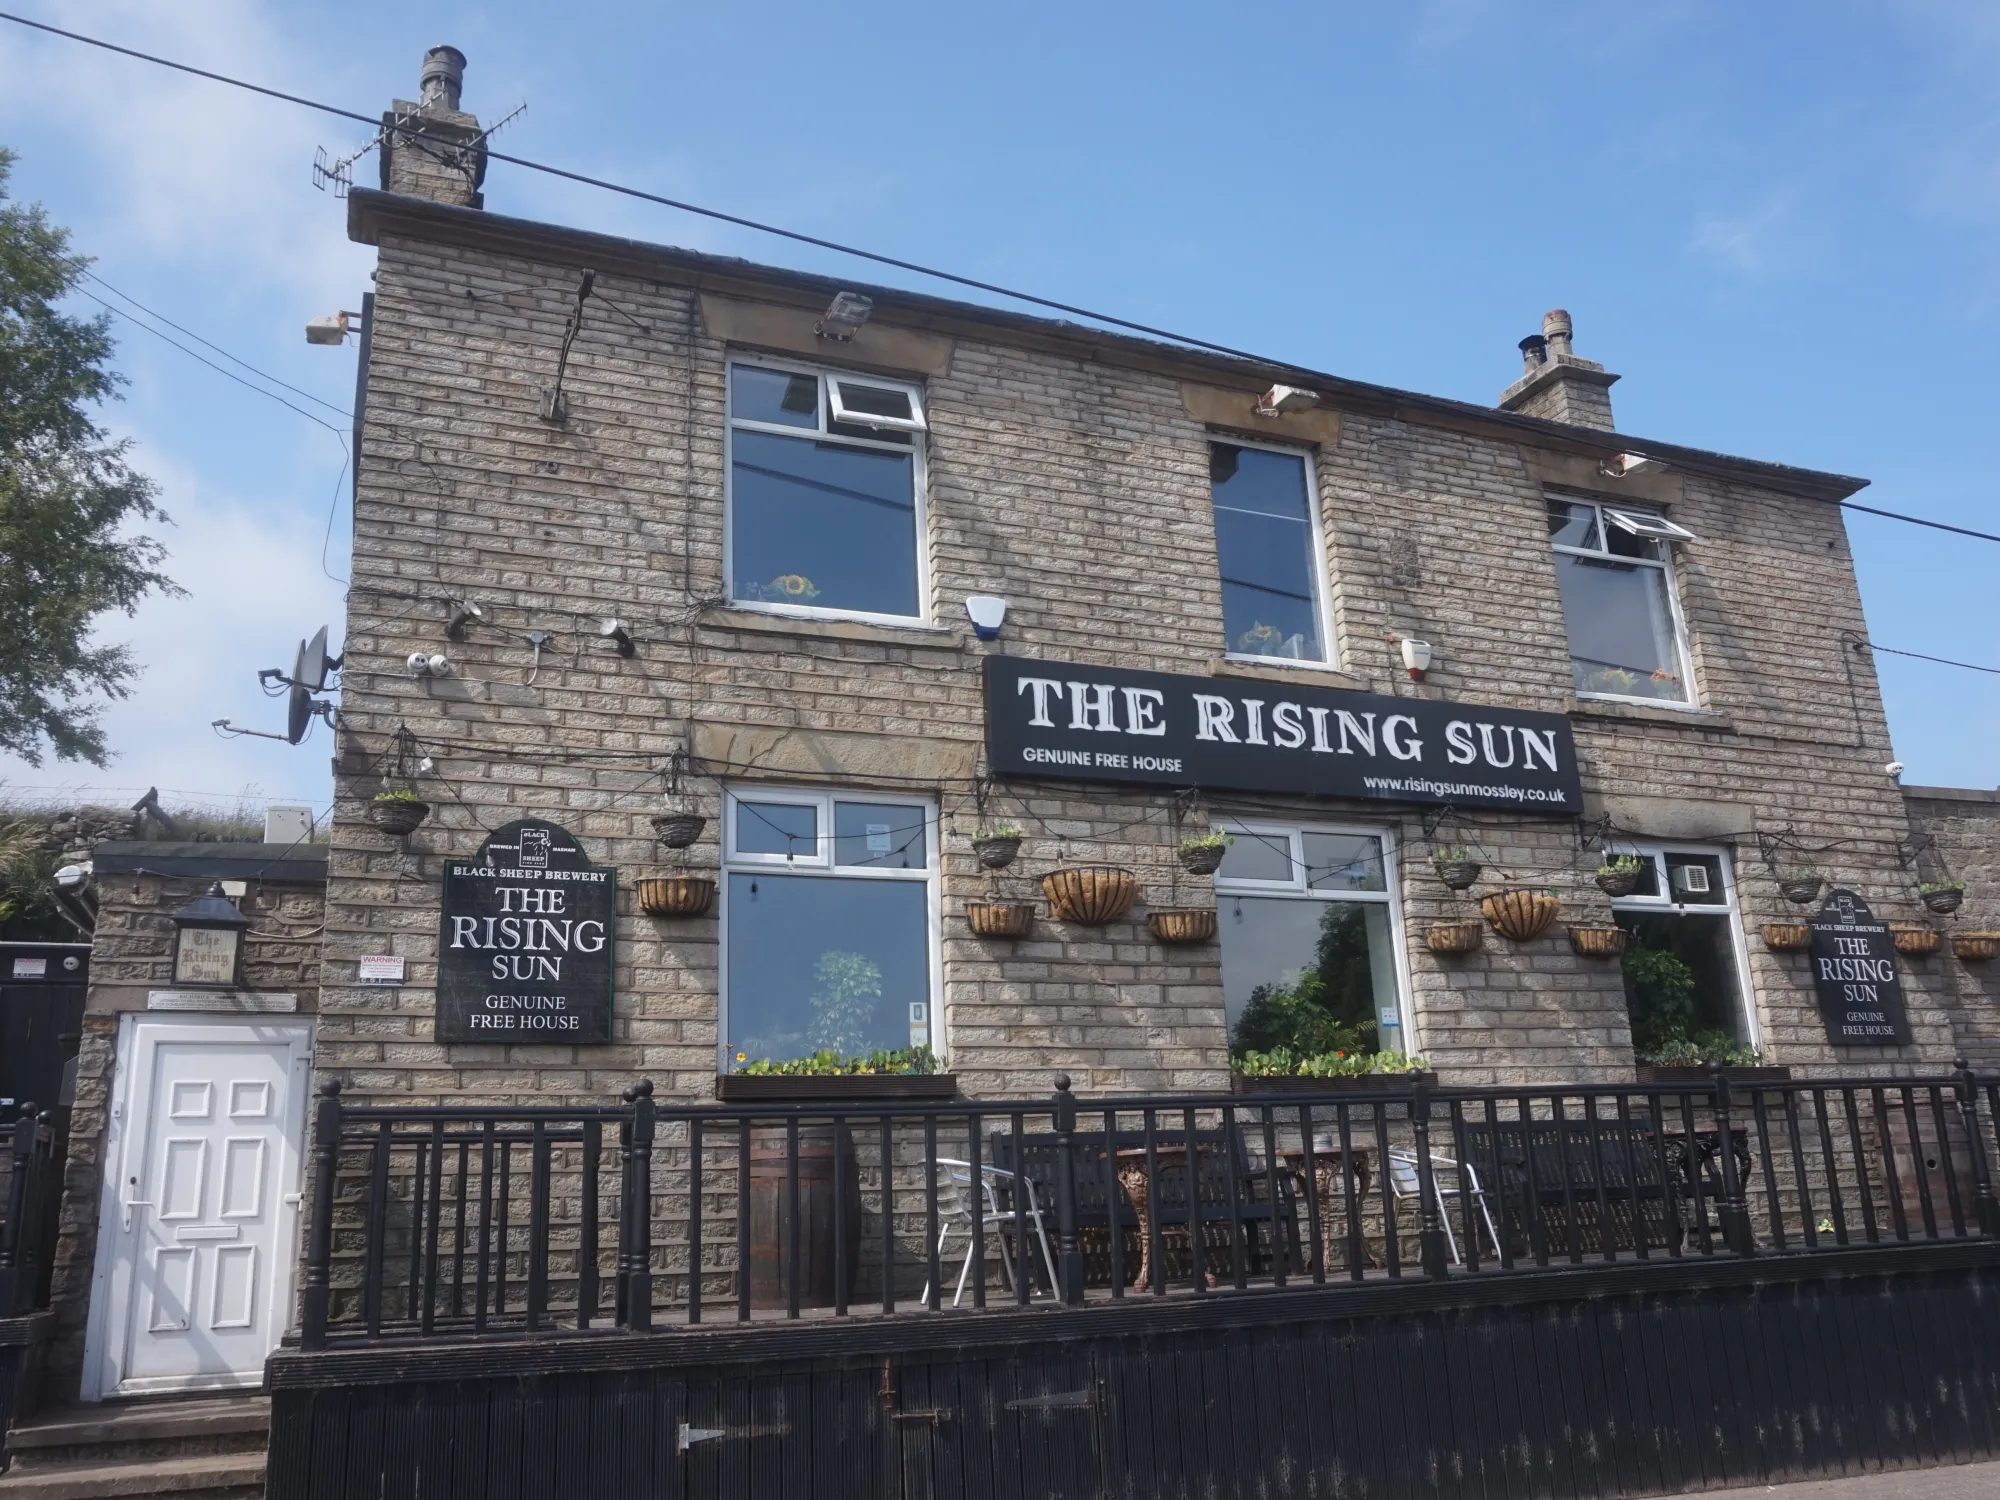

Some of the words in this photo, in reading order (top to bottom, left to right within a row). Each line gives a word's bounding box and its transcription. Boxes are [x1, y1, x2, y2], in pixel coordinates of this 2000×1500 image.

[1017, 677, 1166, 736] THE
[1192, 693, 1424, 762] RISING
[1445, 720, 1558, 771] SUN
[1023, 747, 1091, 766] GENUINE
[1096, 753, 1129, 769] FREE
[1133, 756, 1182, 772] HOUSE
[1364, 776, 1566, 803] www.risingsunmossley.co.uk
[453, 867, 496, 877] BLACK
[499, 868, 542, 879] SHEEP
[545, 870, 607, 882] BREWERY
[495, 887, 566, 914] THE
[450, 916, 607, 953] RISING
[1855, 925, 1885, 933] BREWERY
[192, 931, 220, 949] The
[1834, 937, 1871, 956] THE
[181, 949, 228, 967] Rising
[363, 956, 402, 964] WARNING
[188, 964, 220, 982] Sun
[492, 955, 562, 981] SUN
[1818, 957, 1894, 982] RISING
[1843, 984, 1878, 1002] SUN
[485, 995, 566, 1010] GENUINE
[470, 1014, 514, 1028] FREE
[519, 1015, 579, 1030] HOUSE
[1846, 1012, 1885, 1022] GENUINE
[1842, 1025, 1865, 1035] FREE
[1865, 1025, 1895, 1036] HOUSE
